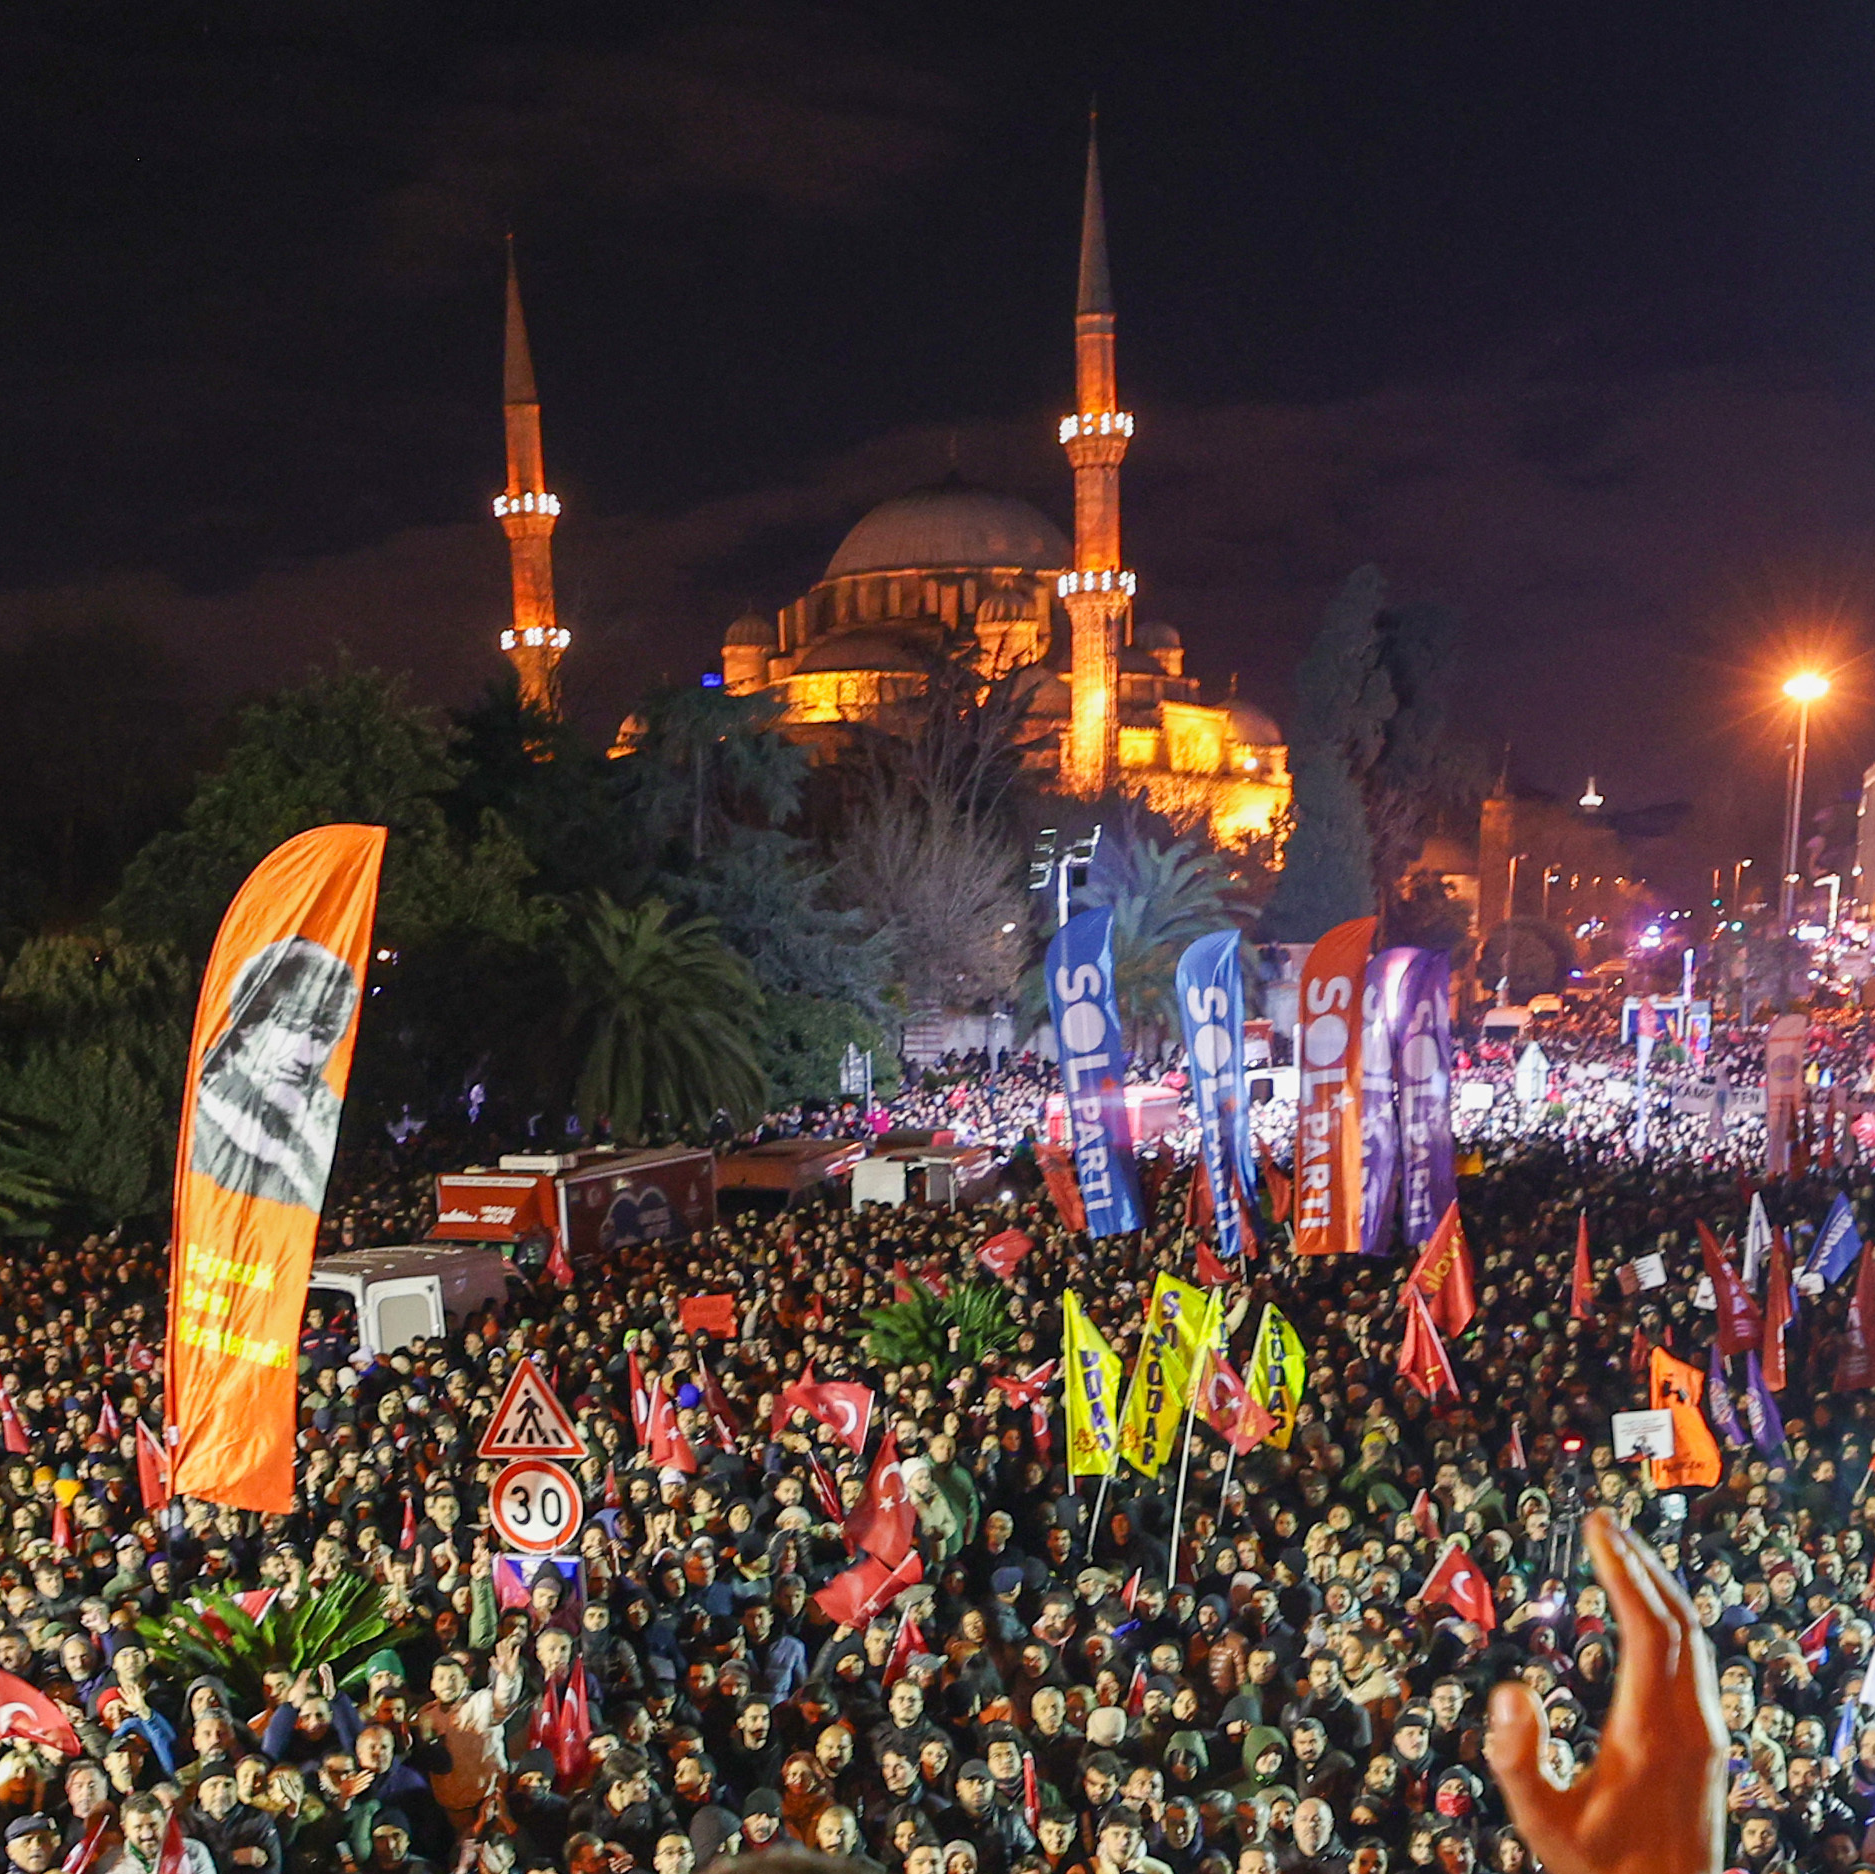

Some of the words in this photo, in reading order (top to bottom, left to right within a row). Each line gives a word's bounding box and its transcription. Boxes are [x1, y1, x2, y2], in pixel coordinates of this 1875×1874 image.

[1055, 963, 1110, 1093] SOL
[1186, 984, 1236, 1114] SOL
[1300, 974, 1352, 1107] SOL
[1403, 999, 1441, 1108] SOL
[512, 1486, 563, 1527] 30
